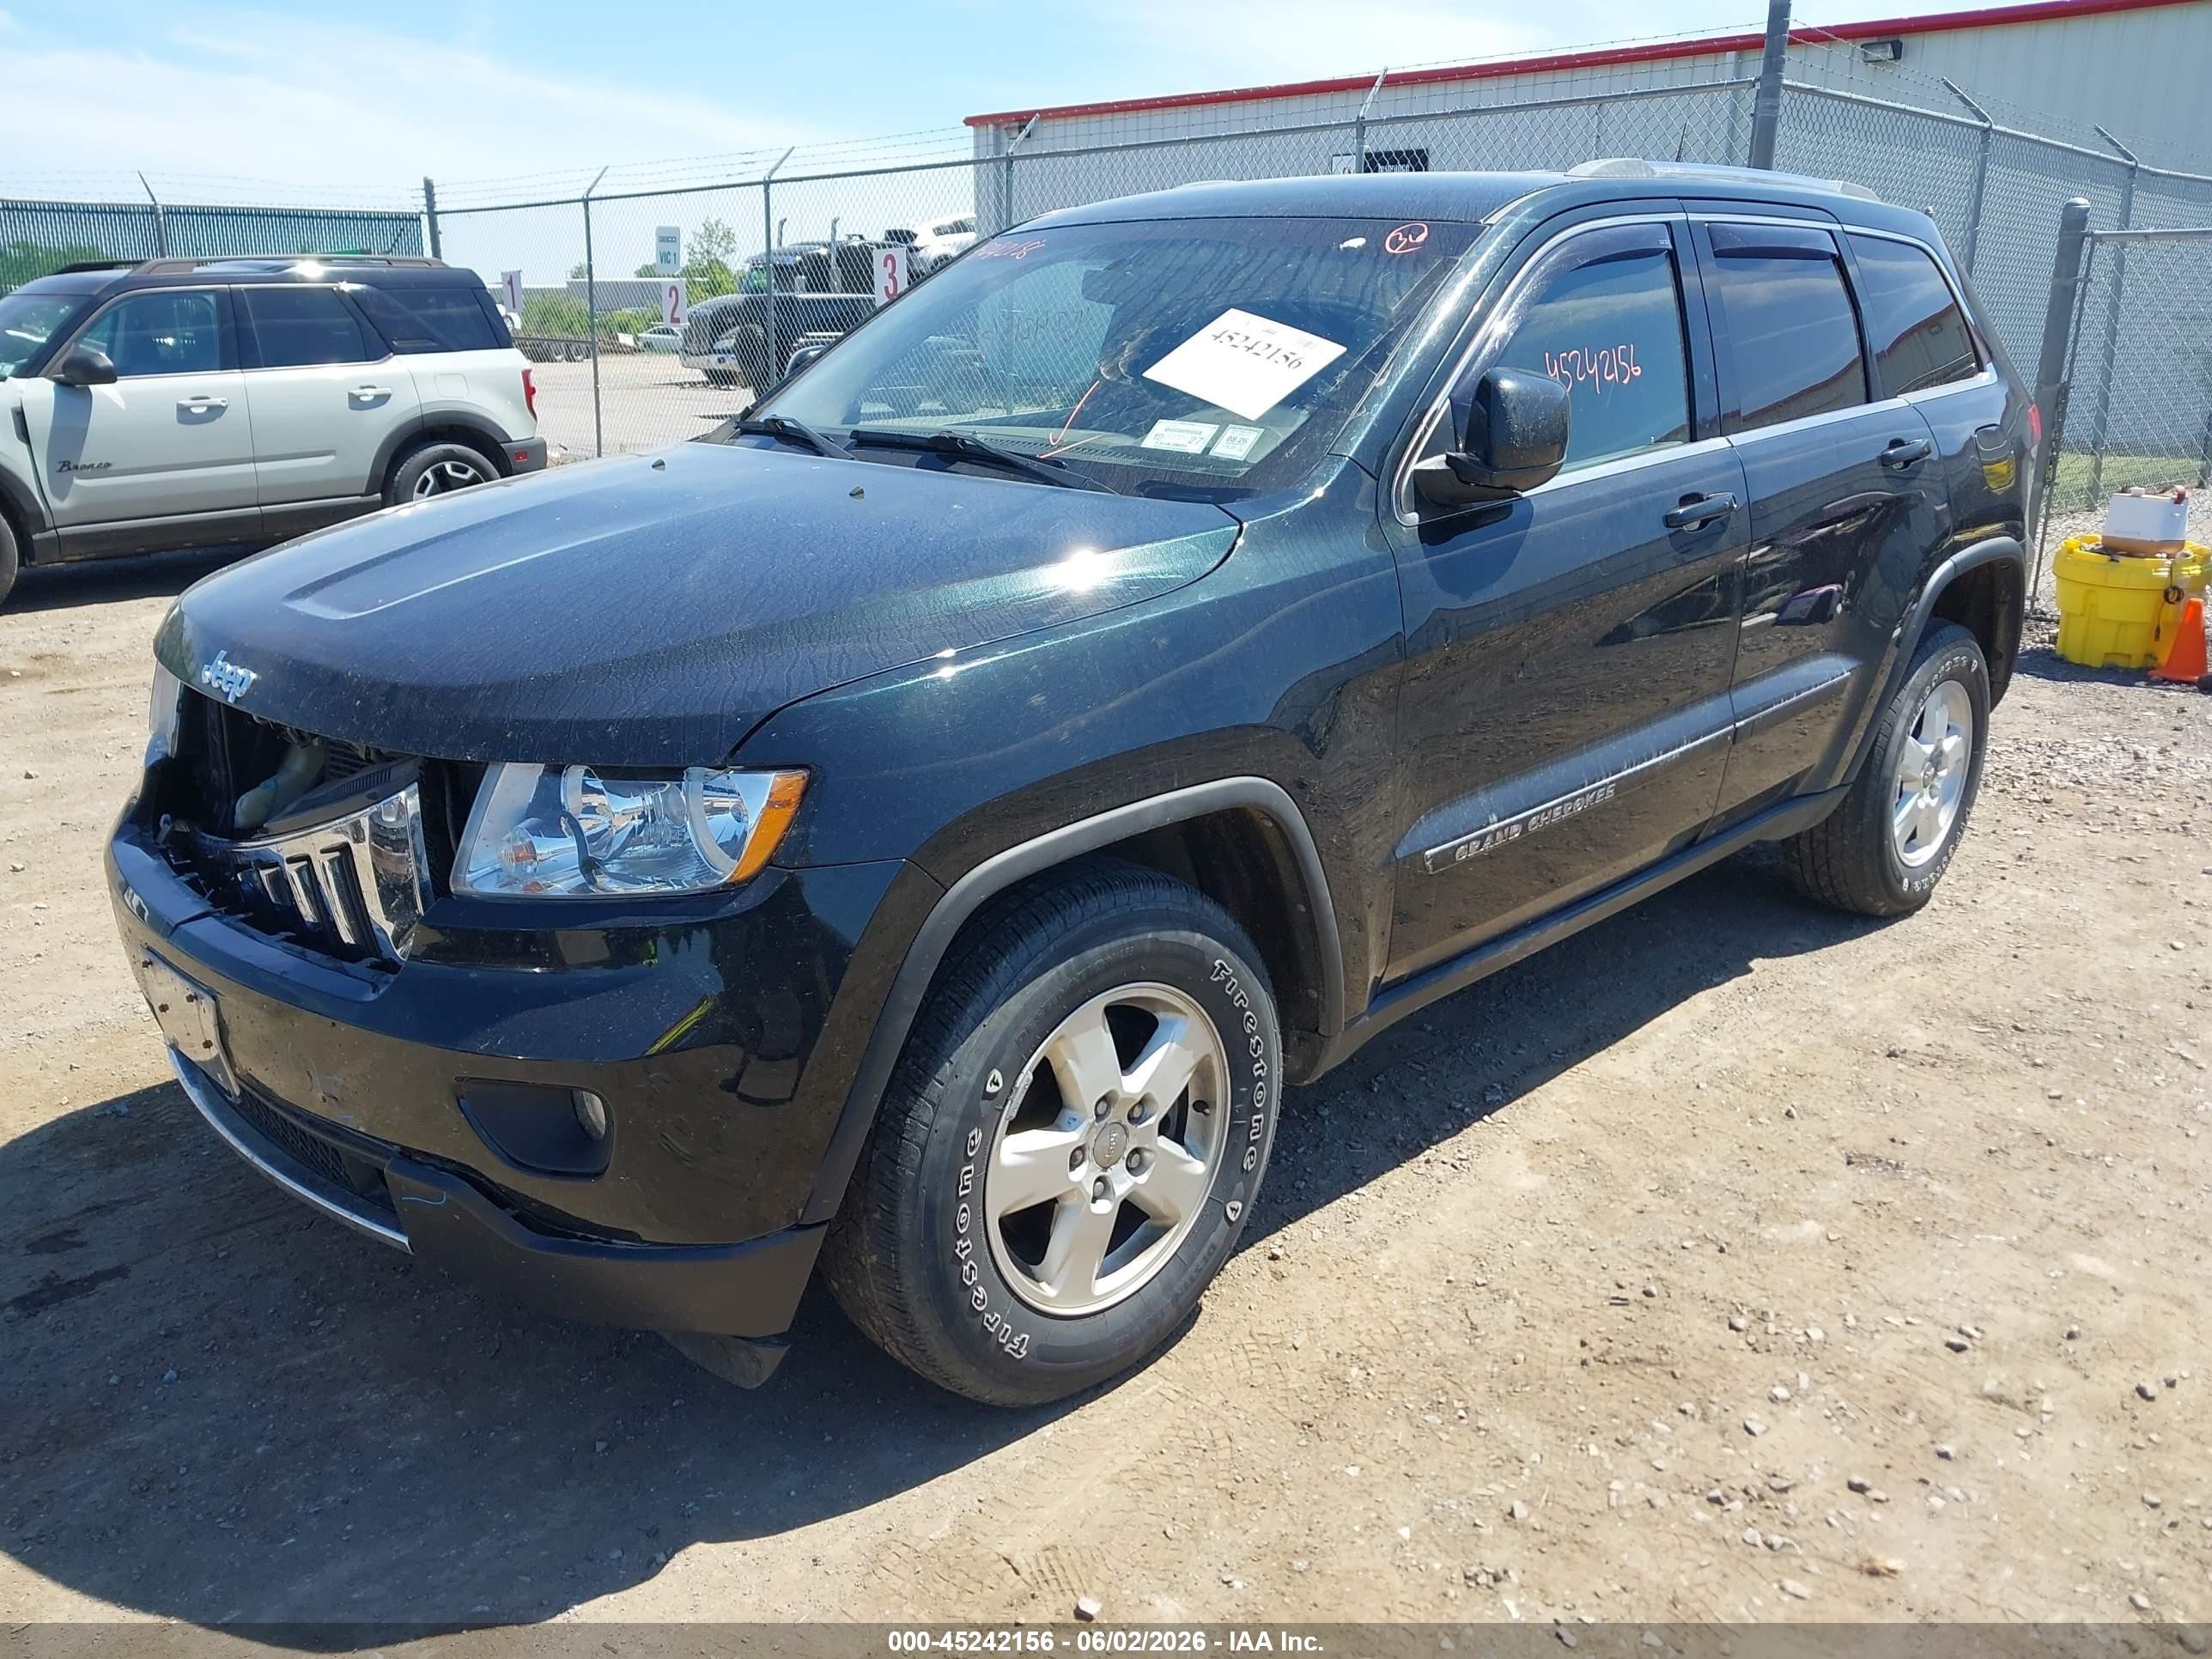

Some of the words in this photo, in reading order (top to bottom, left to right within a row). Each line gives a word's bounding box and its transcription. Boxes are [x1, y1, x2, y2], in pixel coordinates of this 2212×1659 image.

[659, 252, 671, 264] VIC
[672, 252, 677, 264] 1
[883, 253, 898, 300] 3
[507, 275, 516, 309] 1
[669, 285, 681, 324] 2
[1212, 329, 1306, 370] 45242156
[1545, 343, 1641, 394] 45242156
[56, 460, 113, 473] Bronco
[202, 649, 258, 704] Jeep
[1455, 823, 1523, 861] GRAND
[1528, 781, 1617, 832] CHEROKEE
[1210, 959, 1267, 1173] Firestone
[955, 1127, 1030, 1359] Firestone
